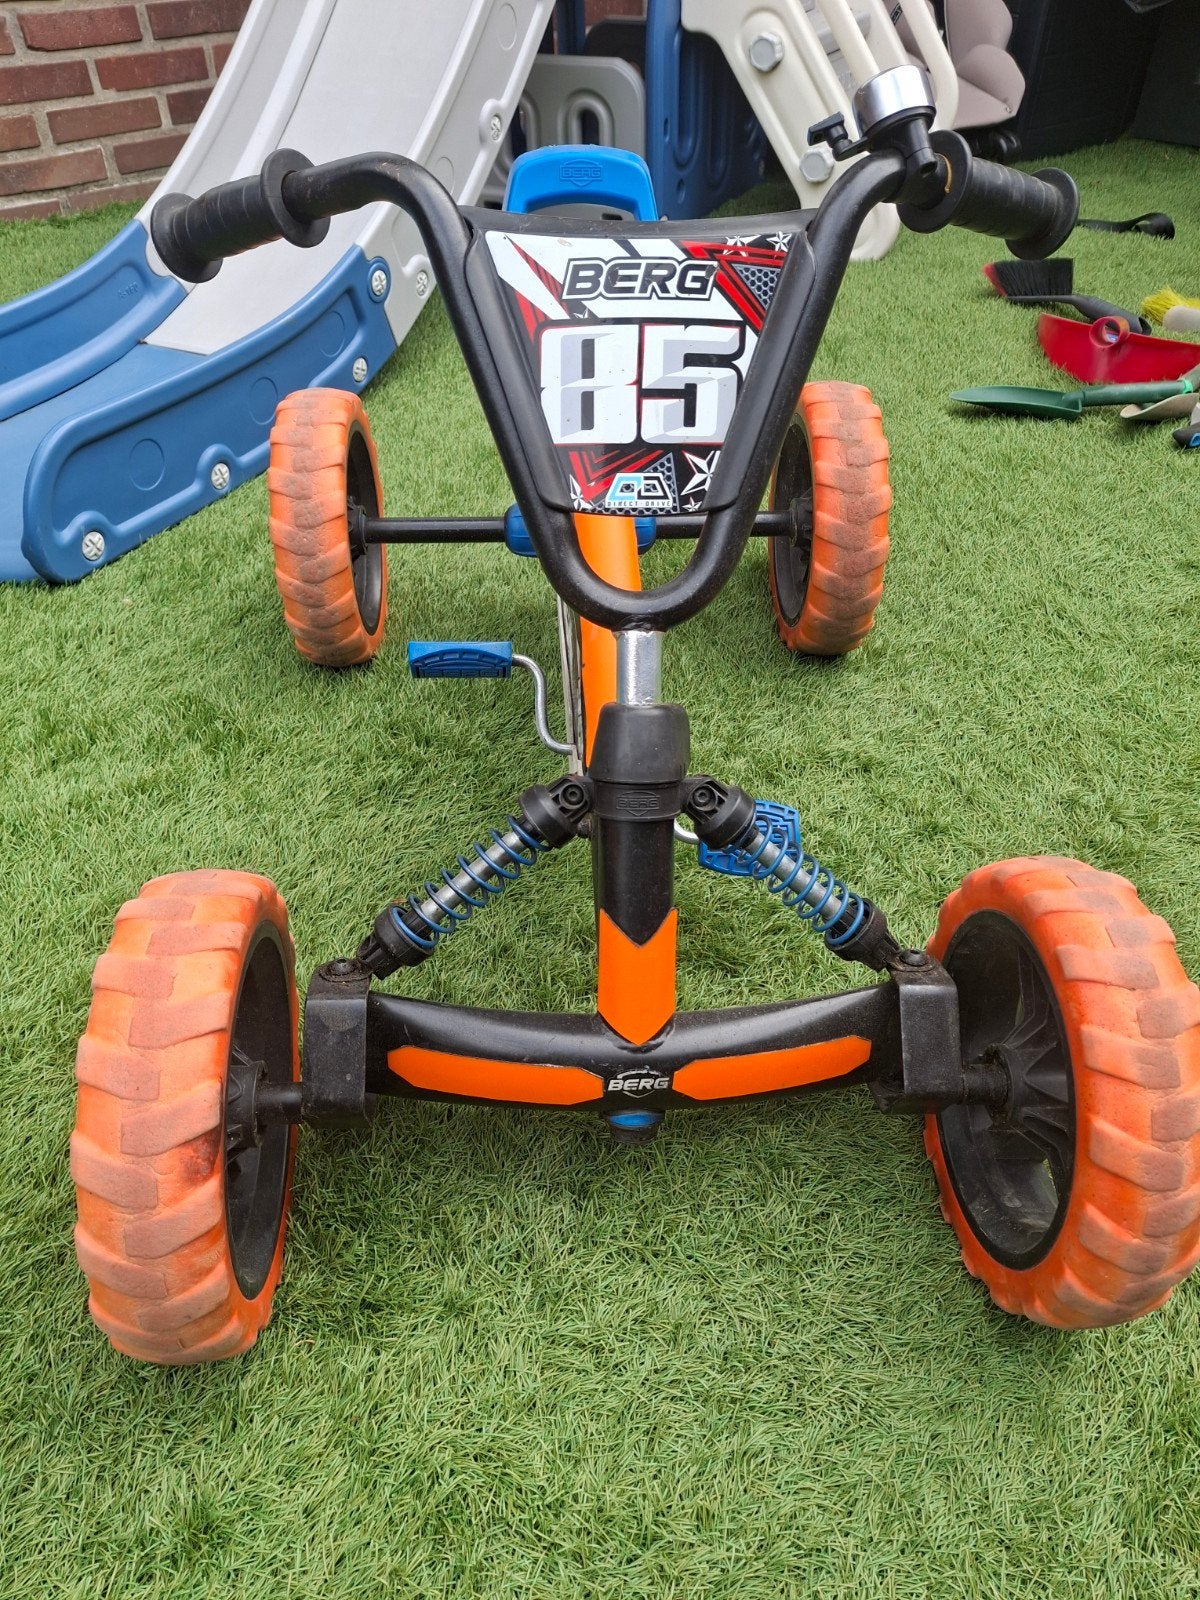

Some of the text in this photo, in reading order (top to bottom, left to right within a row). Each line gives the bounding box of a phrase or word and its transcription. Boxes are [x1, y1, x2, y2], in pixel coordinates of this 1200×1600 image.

[562, 167, 601, 177] BERG
[563, 259, 716, 299] BERG
[540, 324, 740, 444] 85
[617, 800, 660, 808] BERG
[607, 1077, 669, 1091] BERG
